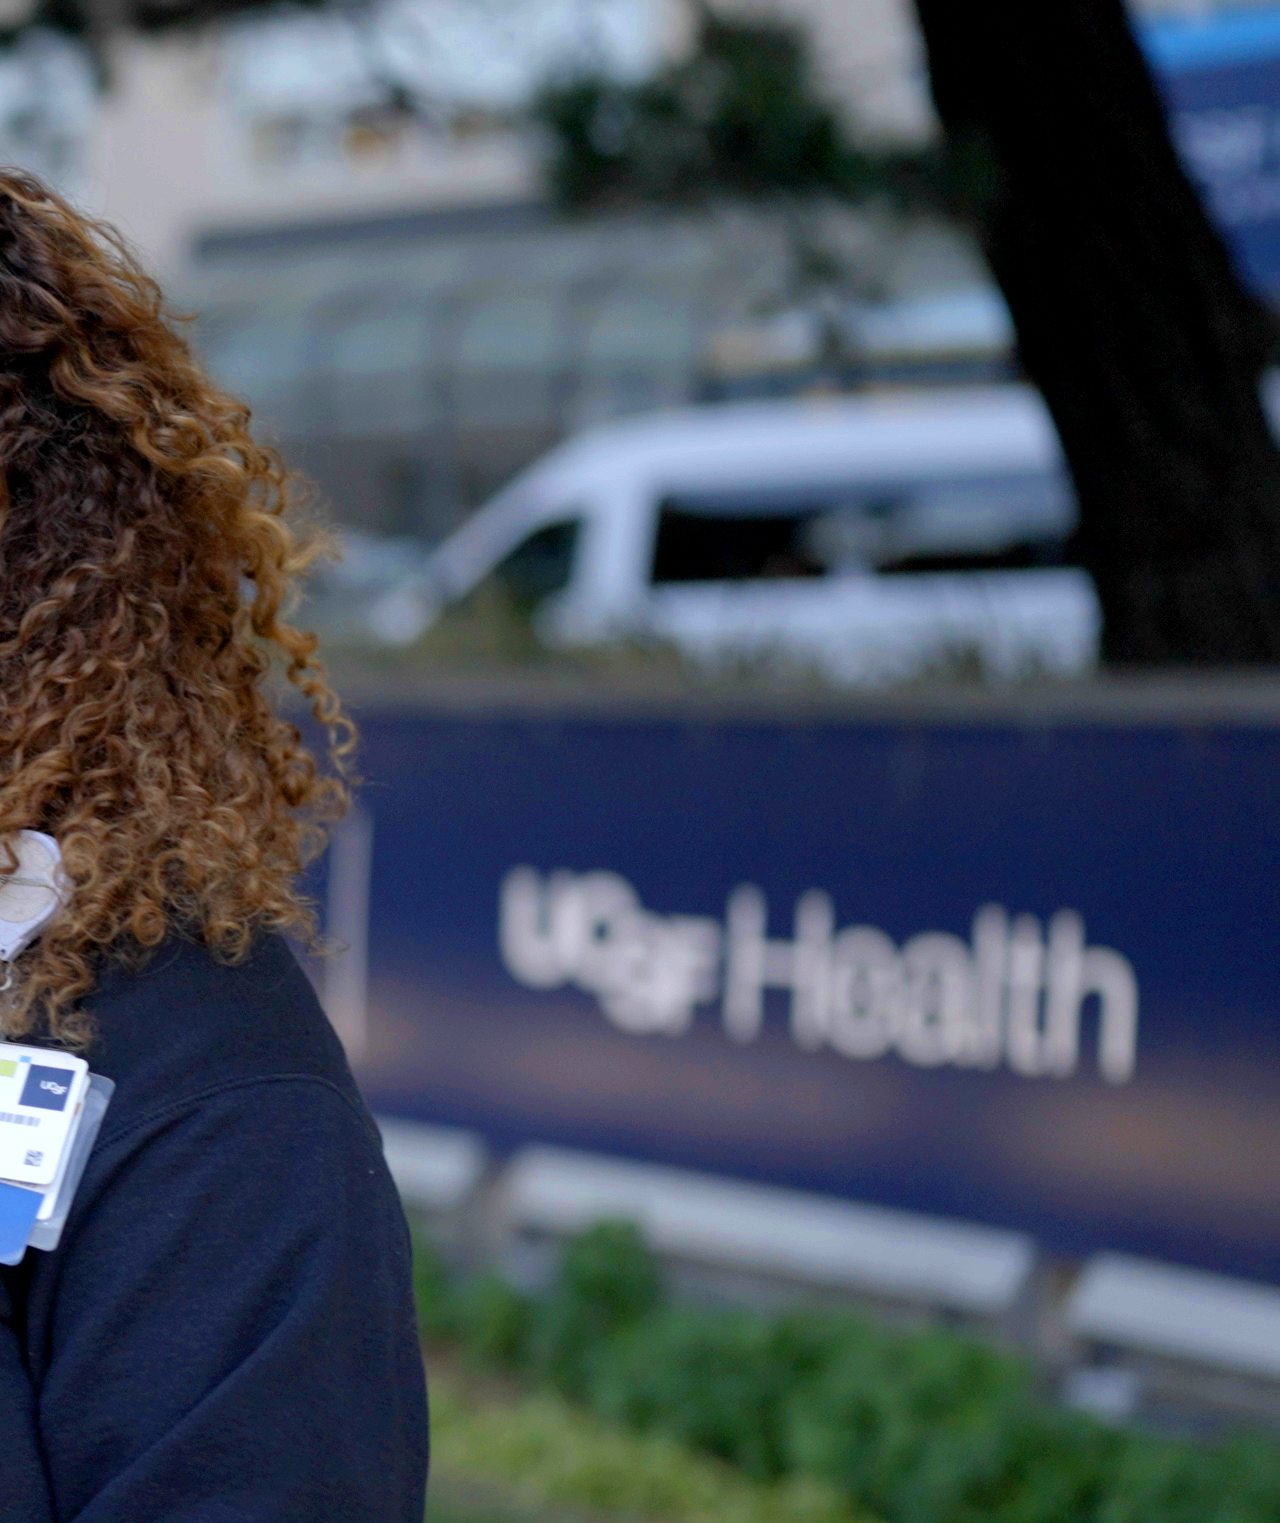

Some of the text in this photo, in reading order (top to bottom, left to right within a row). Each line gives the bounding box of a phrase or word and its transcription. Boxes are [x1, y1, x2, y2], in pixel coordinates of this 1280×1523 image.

[500, 865, 1138, 1084] UCSF Health
[40, 1080, 68, 1095] UCSF
